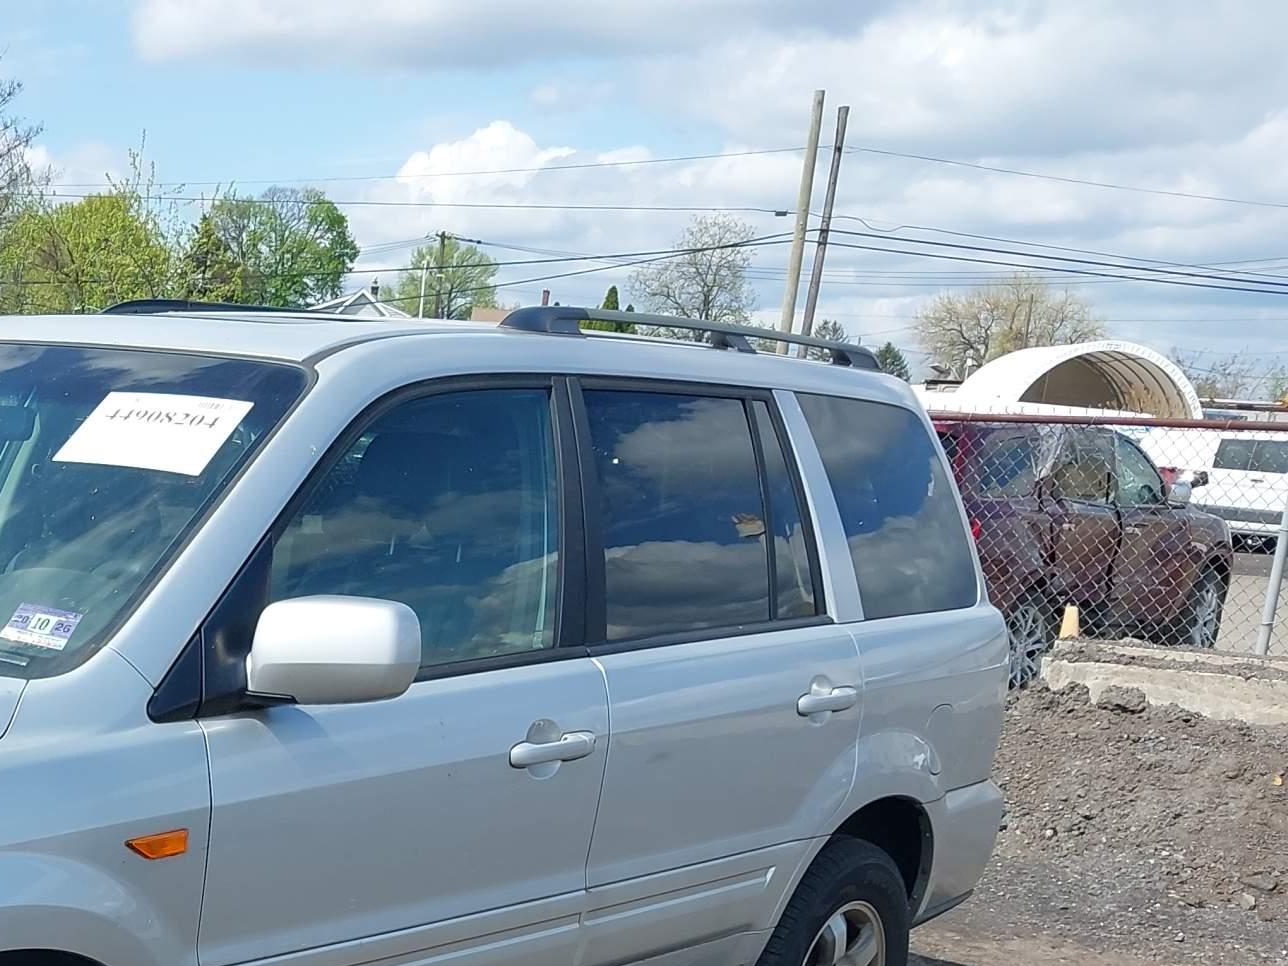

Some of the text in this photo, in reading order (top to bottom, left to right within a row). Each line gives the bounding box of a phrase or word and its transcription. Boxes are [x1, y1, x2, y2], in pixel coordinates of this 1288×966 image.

[105, 407, 221, 430] 44908204
[13, 613, 72, 634] 20 10 26
